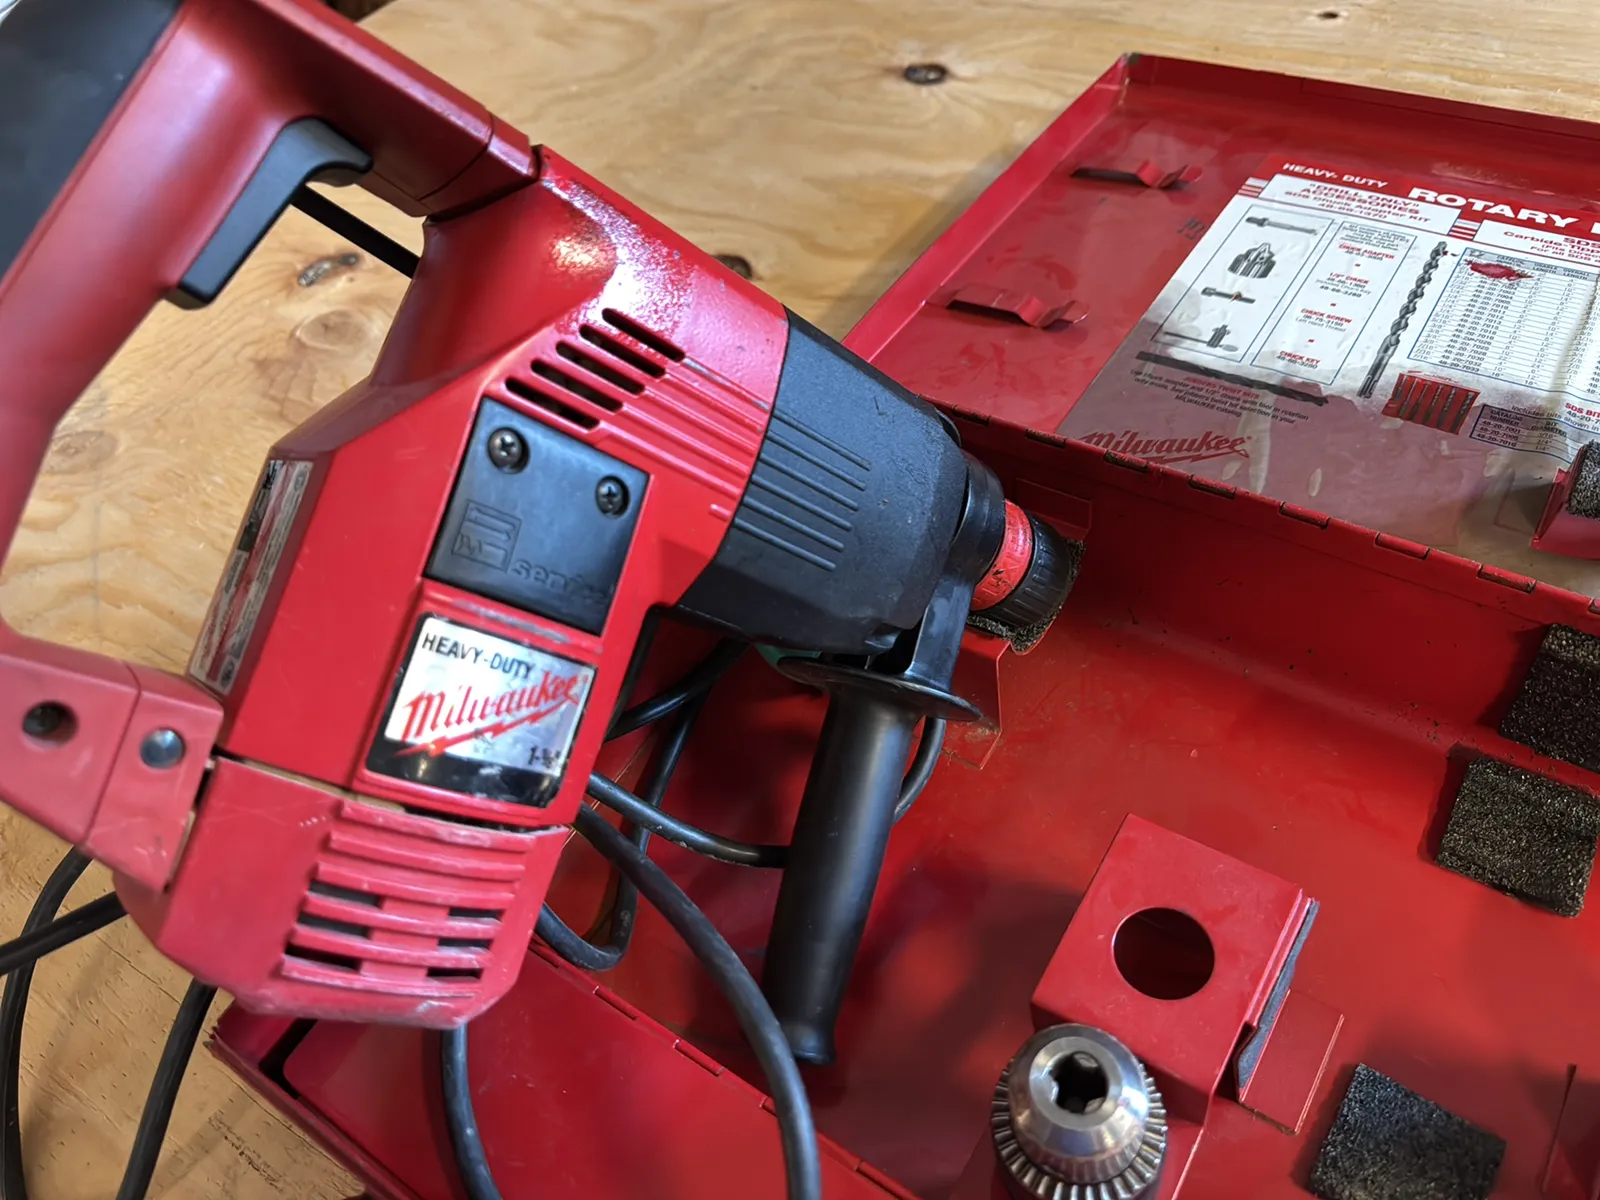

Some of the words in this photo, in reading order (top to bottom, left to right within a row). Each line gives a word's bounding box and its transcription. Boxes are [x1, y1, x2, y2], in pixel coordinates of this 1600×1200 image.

[1342, 175, 1388, 188] DUTY
[1301, 188, 1420, 215] ACCESSORIES
[1407, 187, 1579, 228] ROTARY
[1409, 215, 1431, 223] KIT
[1363, 249, 1395, 259] ADAPTER
[1345, 275, 1370, 285] CHUCK
[1300, 308, 1325, 317] CHUCK
[1326, 314, 1352, 324] SCREW
[1279, 350, 1305, 361] CHUCK
[1306, 356, 1321, 365] KEY
[1175, 394, 1216, 410] MILWAUKEE
[1565, 402, 1584, 414] SDS
[1281, 409, 1309, 420] rotation
[1490, 409, 1523, 421] CATALOG
[1490, 415, 1520, 426] NUMBER
[1511, 404, 1544, 418] Includes
[1564, 416, 1590, 430] shown
[1080, 430, 1250, 458] Milwaukee
[422, 633, 535, 680] HEAVY-DUTY
[402, 669, 579, 742] Milwaukee
